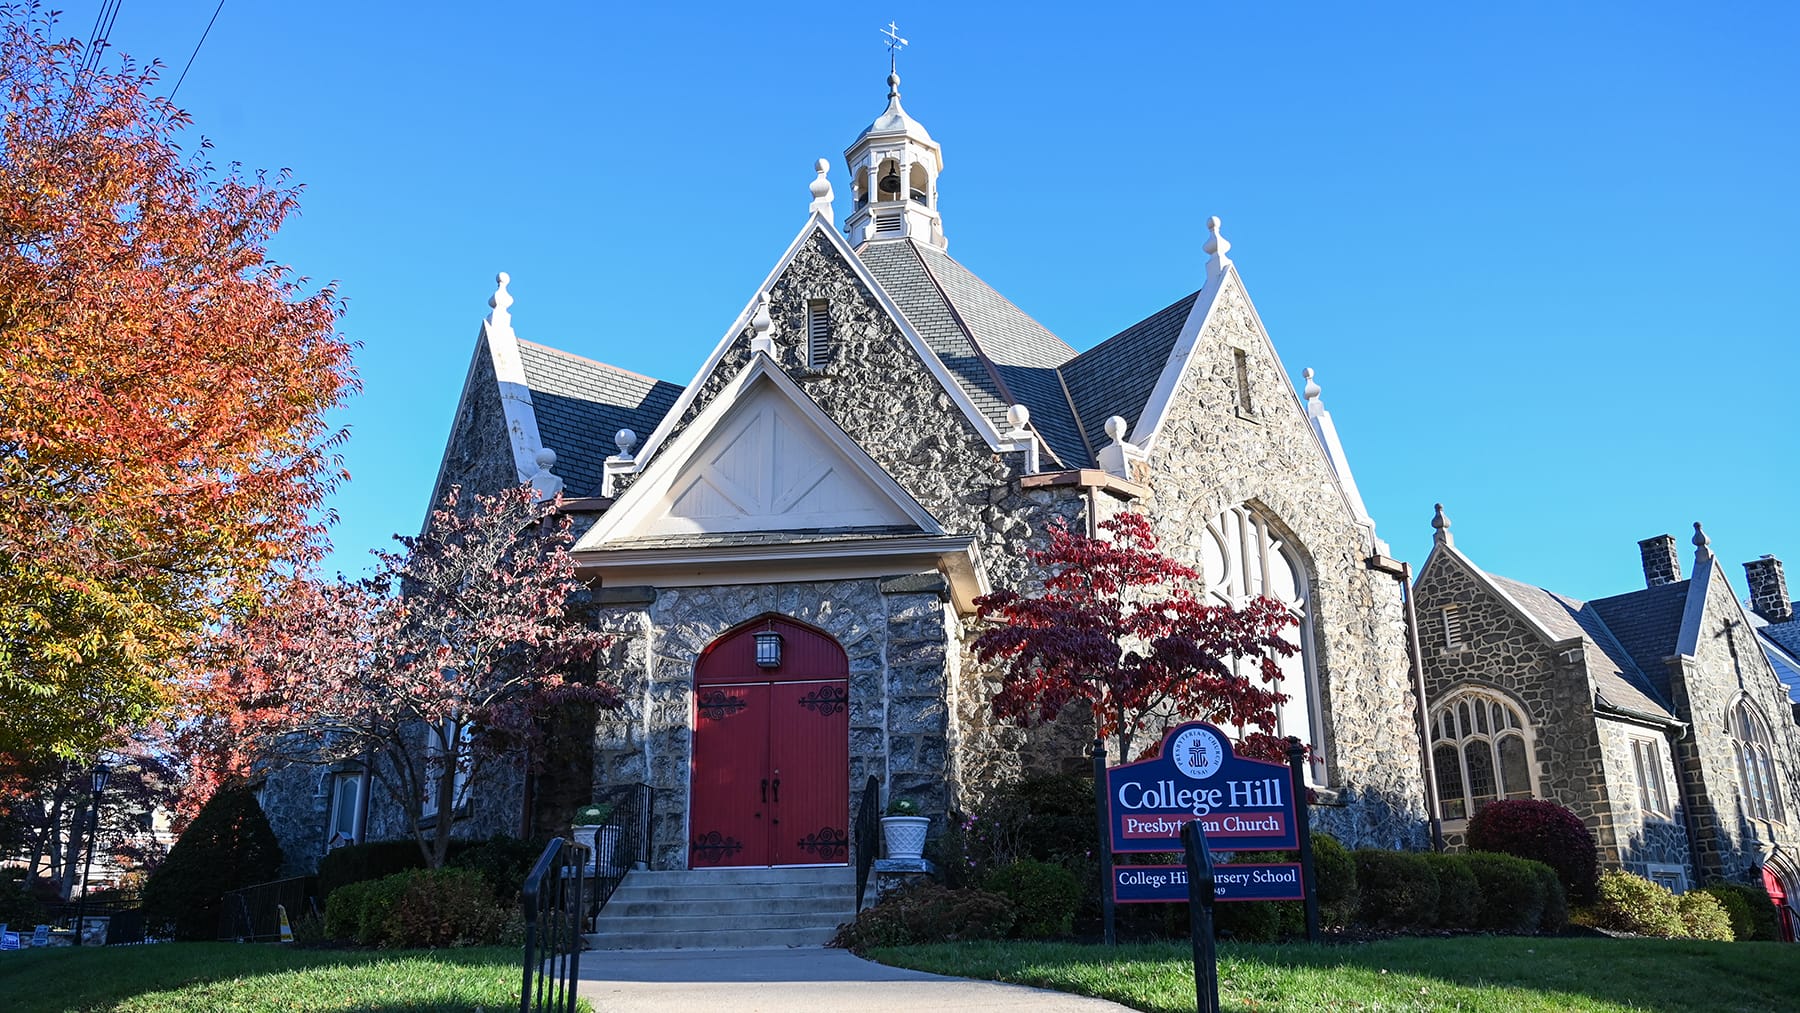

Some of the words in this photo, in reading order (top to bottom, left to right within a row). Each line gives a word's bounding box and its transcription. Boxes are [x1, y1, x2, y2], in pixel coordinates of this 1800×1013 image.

[1207, 736, 1221, 766] CHURCH
[1119, 780, 1222, 816] College
[1226, 779, 1284, 808] Hill
[1127, 817, 1220, 837] Presbytan
[1223, 816, 1280, 832] Church
[1119, 872, 1167, 888] College
[1253, 869, 1297, 883] School
